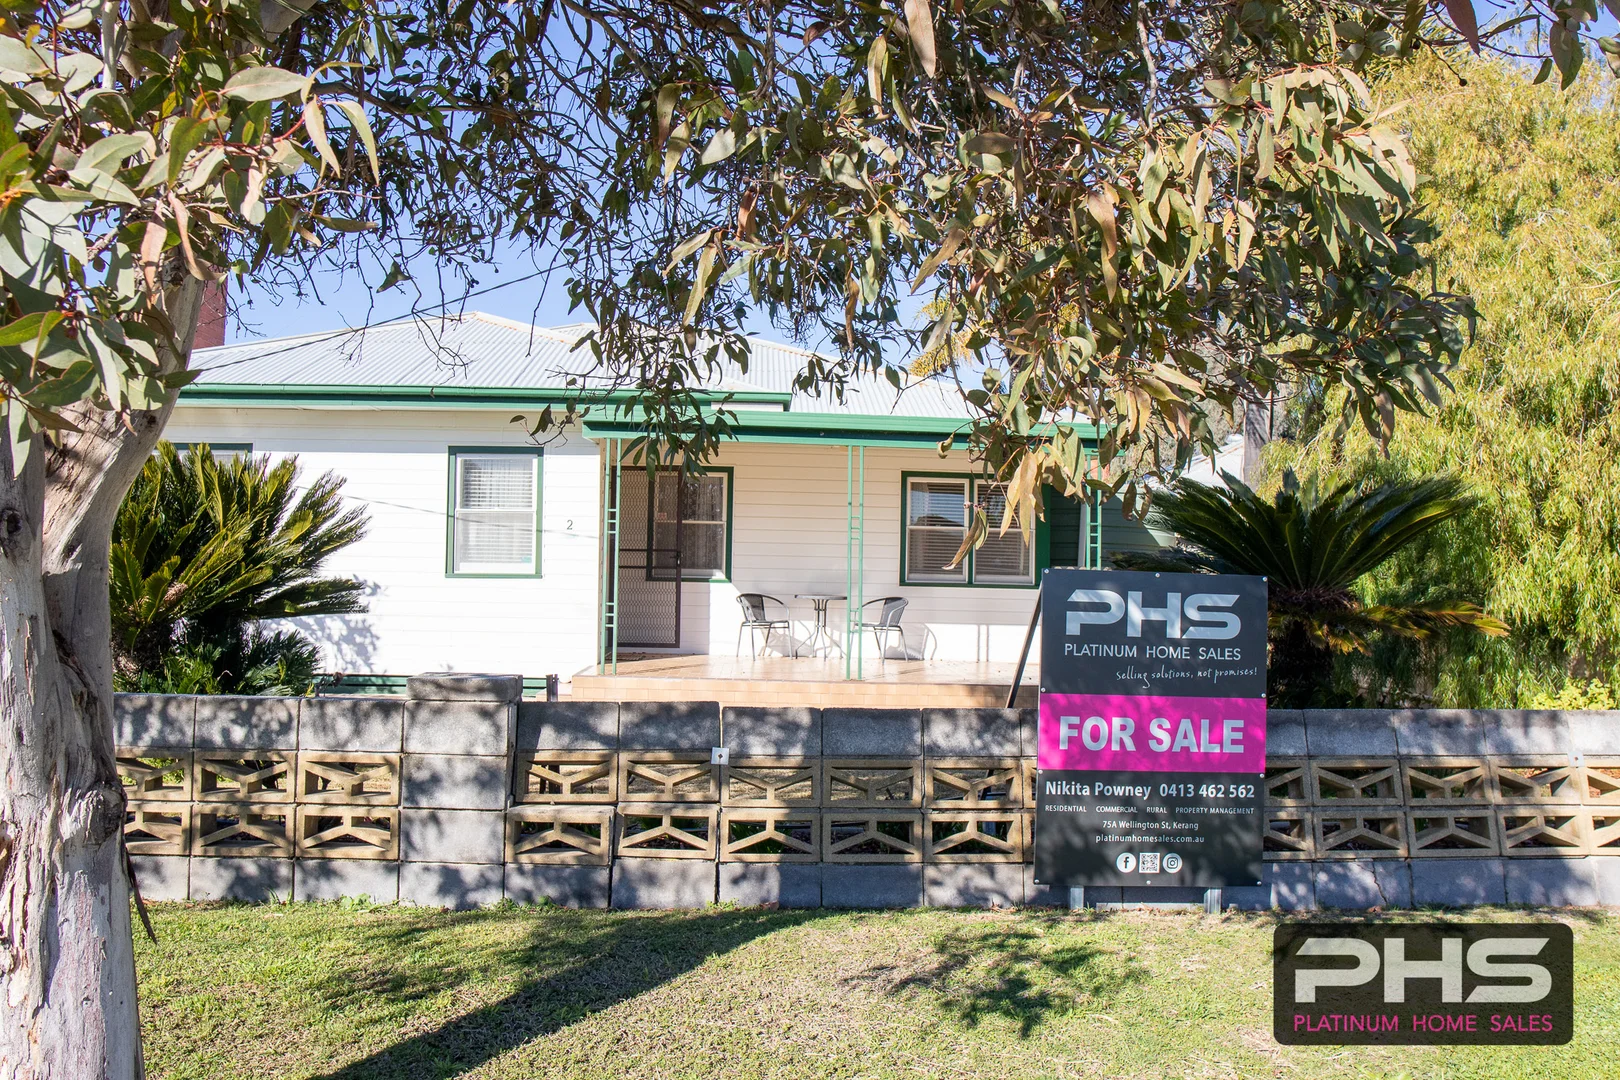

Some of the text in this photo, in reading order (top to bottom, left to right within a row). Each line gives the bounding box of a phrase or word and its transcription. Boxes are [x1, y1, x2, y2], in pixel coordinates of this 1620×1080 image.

[567, 520, 573, 530] 2
[1066, 589, 1241, 640] PHS
[1064, 644, 1241, 660] PLATINUM HOME SALES
[1197, 669, 1213, 678] not
[1214, 667, 1257, 683] promises!
[1059, 716, 1244, 753] FOR SALE
[1045, 781, 1255, 800] Nikita Powney 0413 462 562
[1103, 820, 1198, 830] 75A Wellington St, Kerang
[1096, 835, 1204, 843] platinumhomesales.com.au
